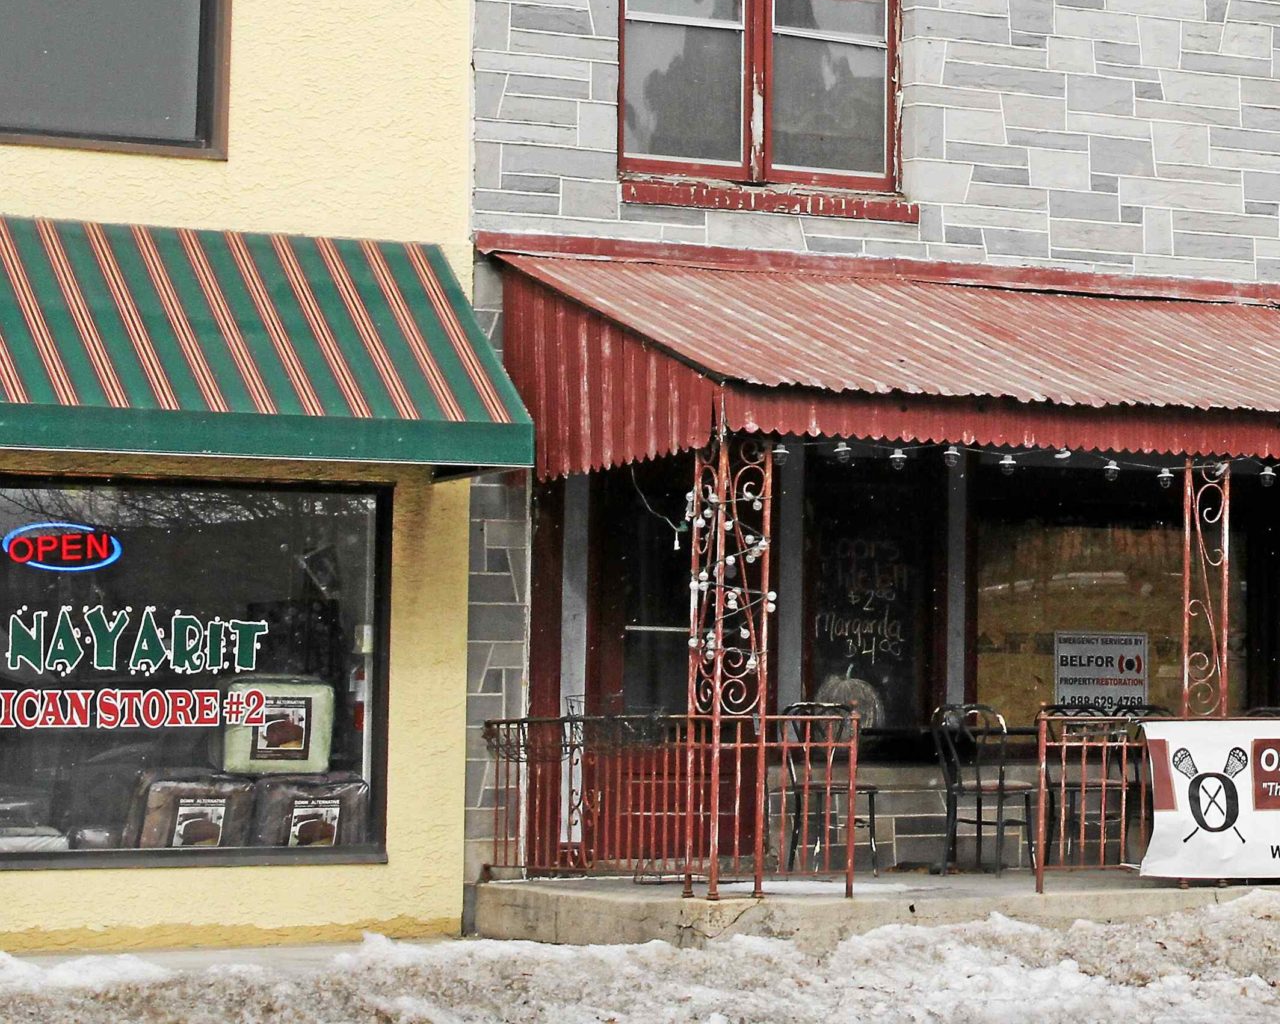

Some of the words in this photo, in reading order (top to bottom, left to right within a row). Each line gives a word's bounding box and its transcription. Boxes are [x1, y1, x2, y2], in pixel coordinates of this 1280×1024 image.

[8, 532, 109, 563] OPEN
[6, 605, 268, 675] NAYARIT
[1058, 637, 1099, 645] EMERGENCY
[1060, 655, 1114, 668] BELFOR
[97, 688, 220, 730] STORE
[224, 688, 265, 726] #2
